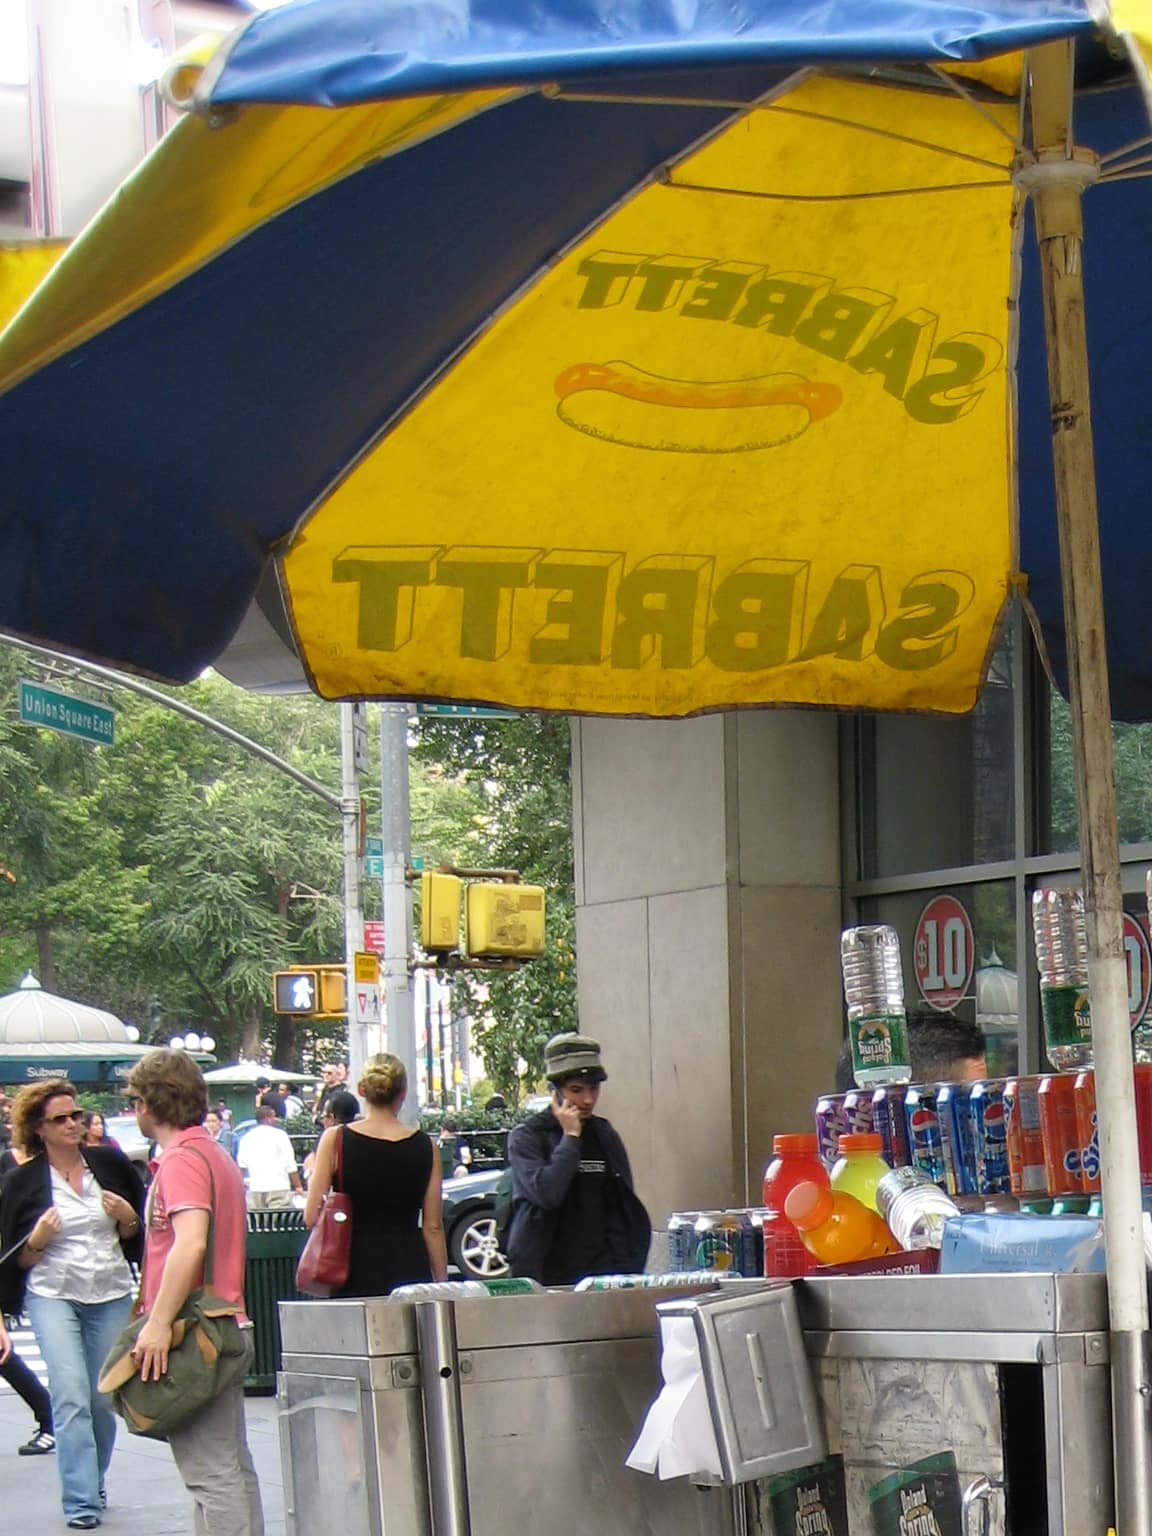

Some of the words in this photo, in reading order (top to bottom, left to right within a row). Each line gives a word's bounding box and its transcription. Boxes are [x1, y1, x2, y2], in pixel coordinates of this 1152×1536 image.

[25, 693, 57, 719] Union
[58, 704, 91, 728] Square
[92, 714, 113, 736] East
[369, 857, 382, 876] E
[917, 917, 966, 991] $10
[858, 1035, 892, 1056] Spring
[26, 1066, 69, 1078] Subway
[797, 1482, 821, 1508] Poland
[900, 1482, 928, 1519] Poland
